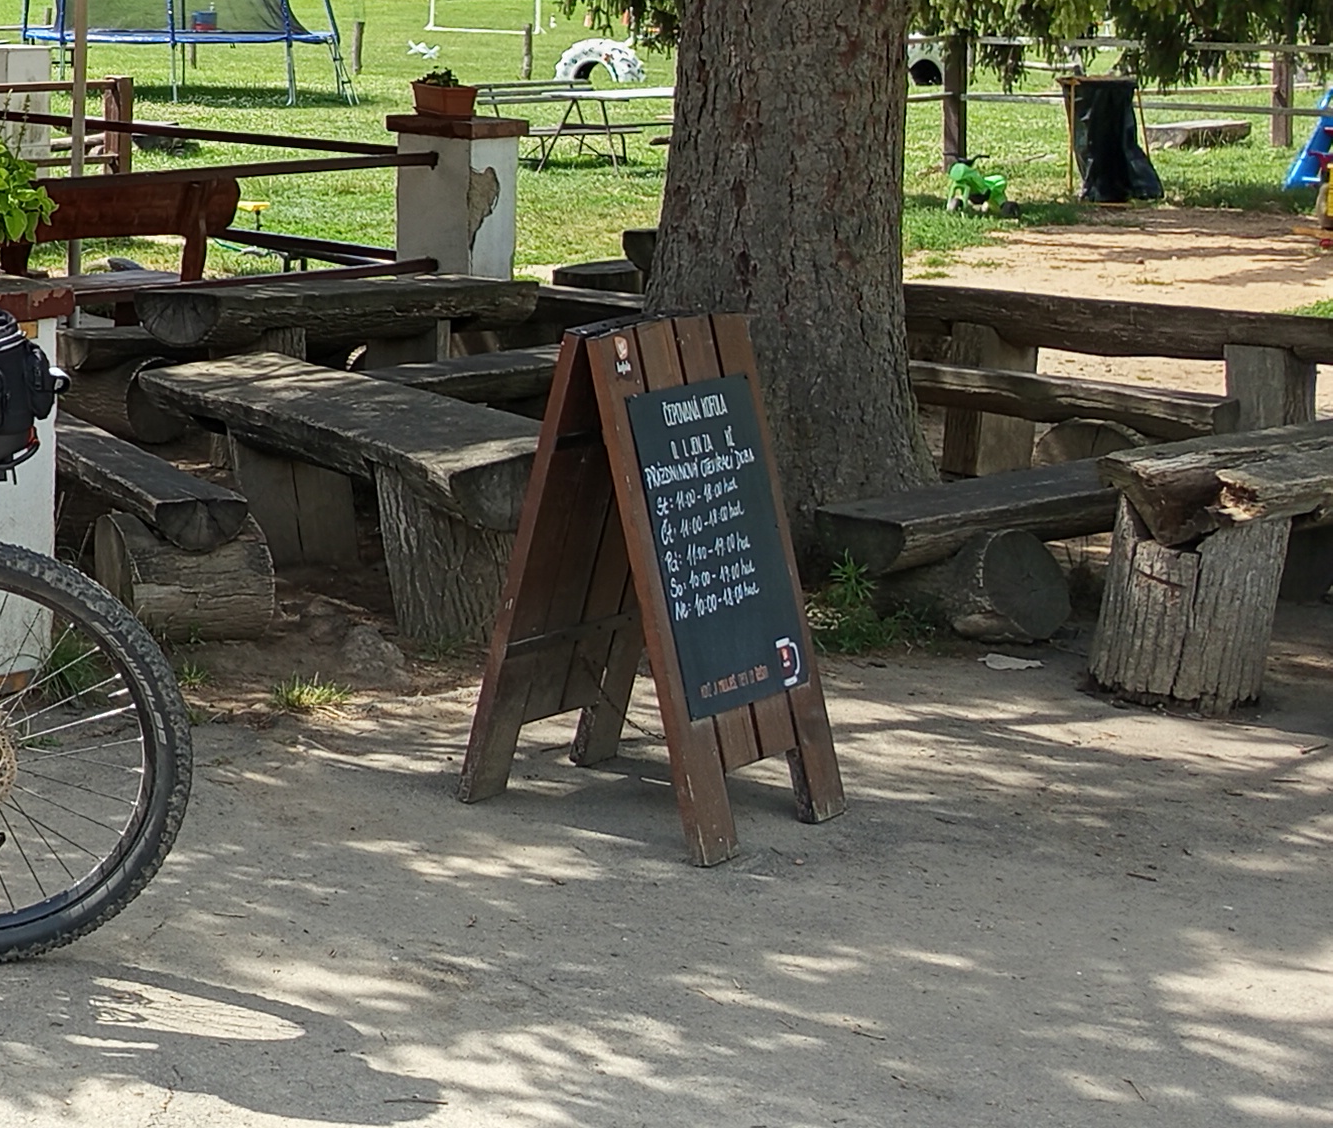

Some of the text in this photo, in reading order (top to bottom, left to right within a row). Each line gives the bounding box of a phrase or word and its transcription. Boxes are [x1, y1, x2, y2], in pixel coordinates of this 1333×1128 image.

[661, 393, 729, 427] ČEPOVANÁ KOFOLA
[701, 433, 714, 453] ZA
